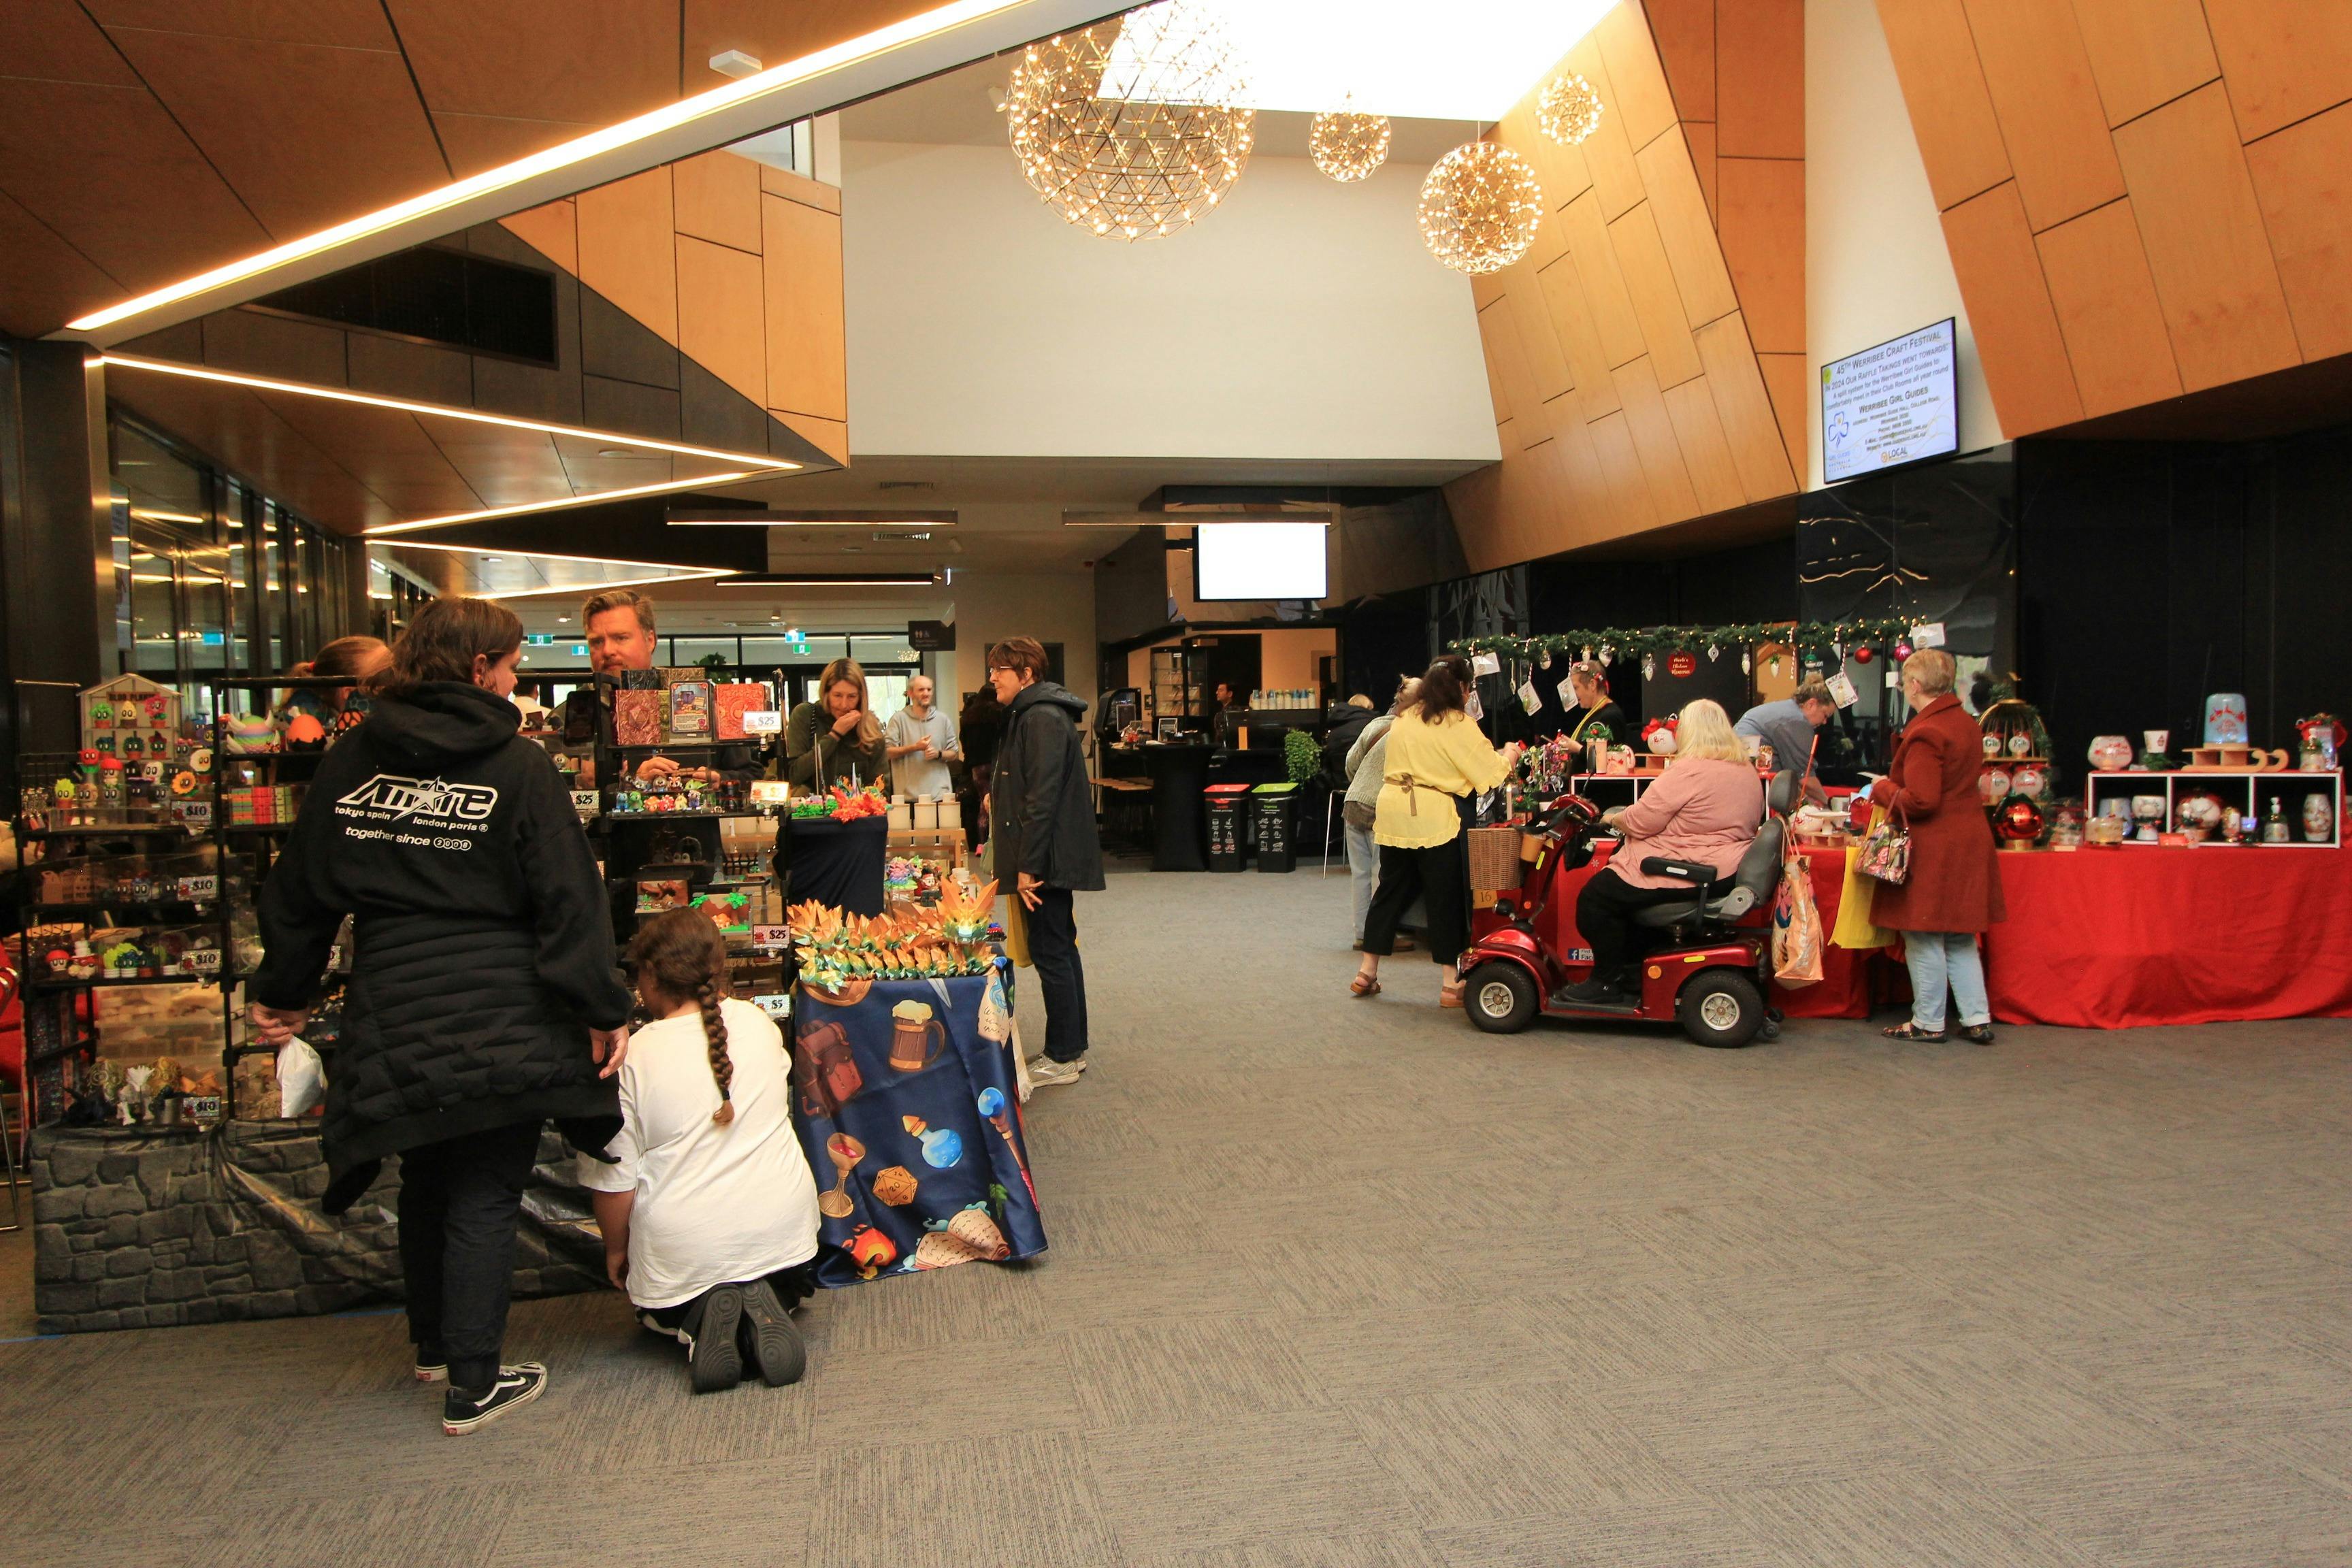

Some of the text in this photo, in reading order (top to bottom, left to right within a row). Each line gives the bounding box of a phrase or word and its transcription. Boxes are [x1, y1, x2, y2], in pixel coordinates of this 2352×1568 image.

[1886, 342, 1907, 357] CRAFT
[1910, 331, 1941, 349] FESTIVAL
[1906, 387, 1928, 399] GUIDES
[757, 716, 774, 726] $25
[576, 795, 593, 804] $25
[186, 805, 207, 815] $10
[335, 806, 391, 820] tokyo spain
[412, 817, 478, 831] london paris
[346, 826, 472, 851] together since 2008
[193, 880, 212, 890] $10
[1481, 892, 1492, 902] 16
[769, 929, 786, 939] $25
[772, 999, 783, 1009] $5
